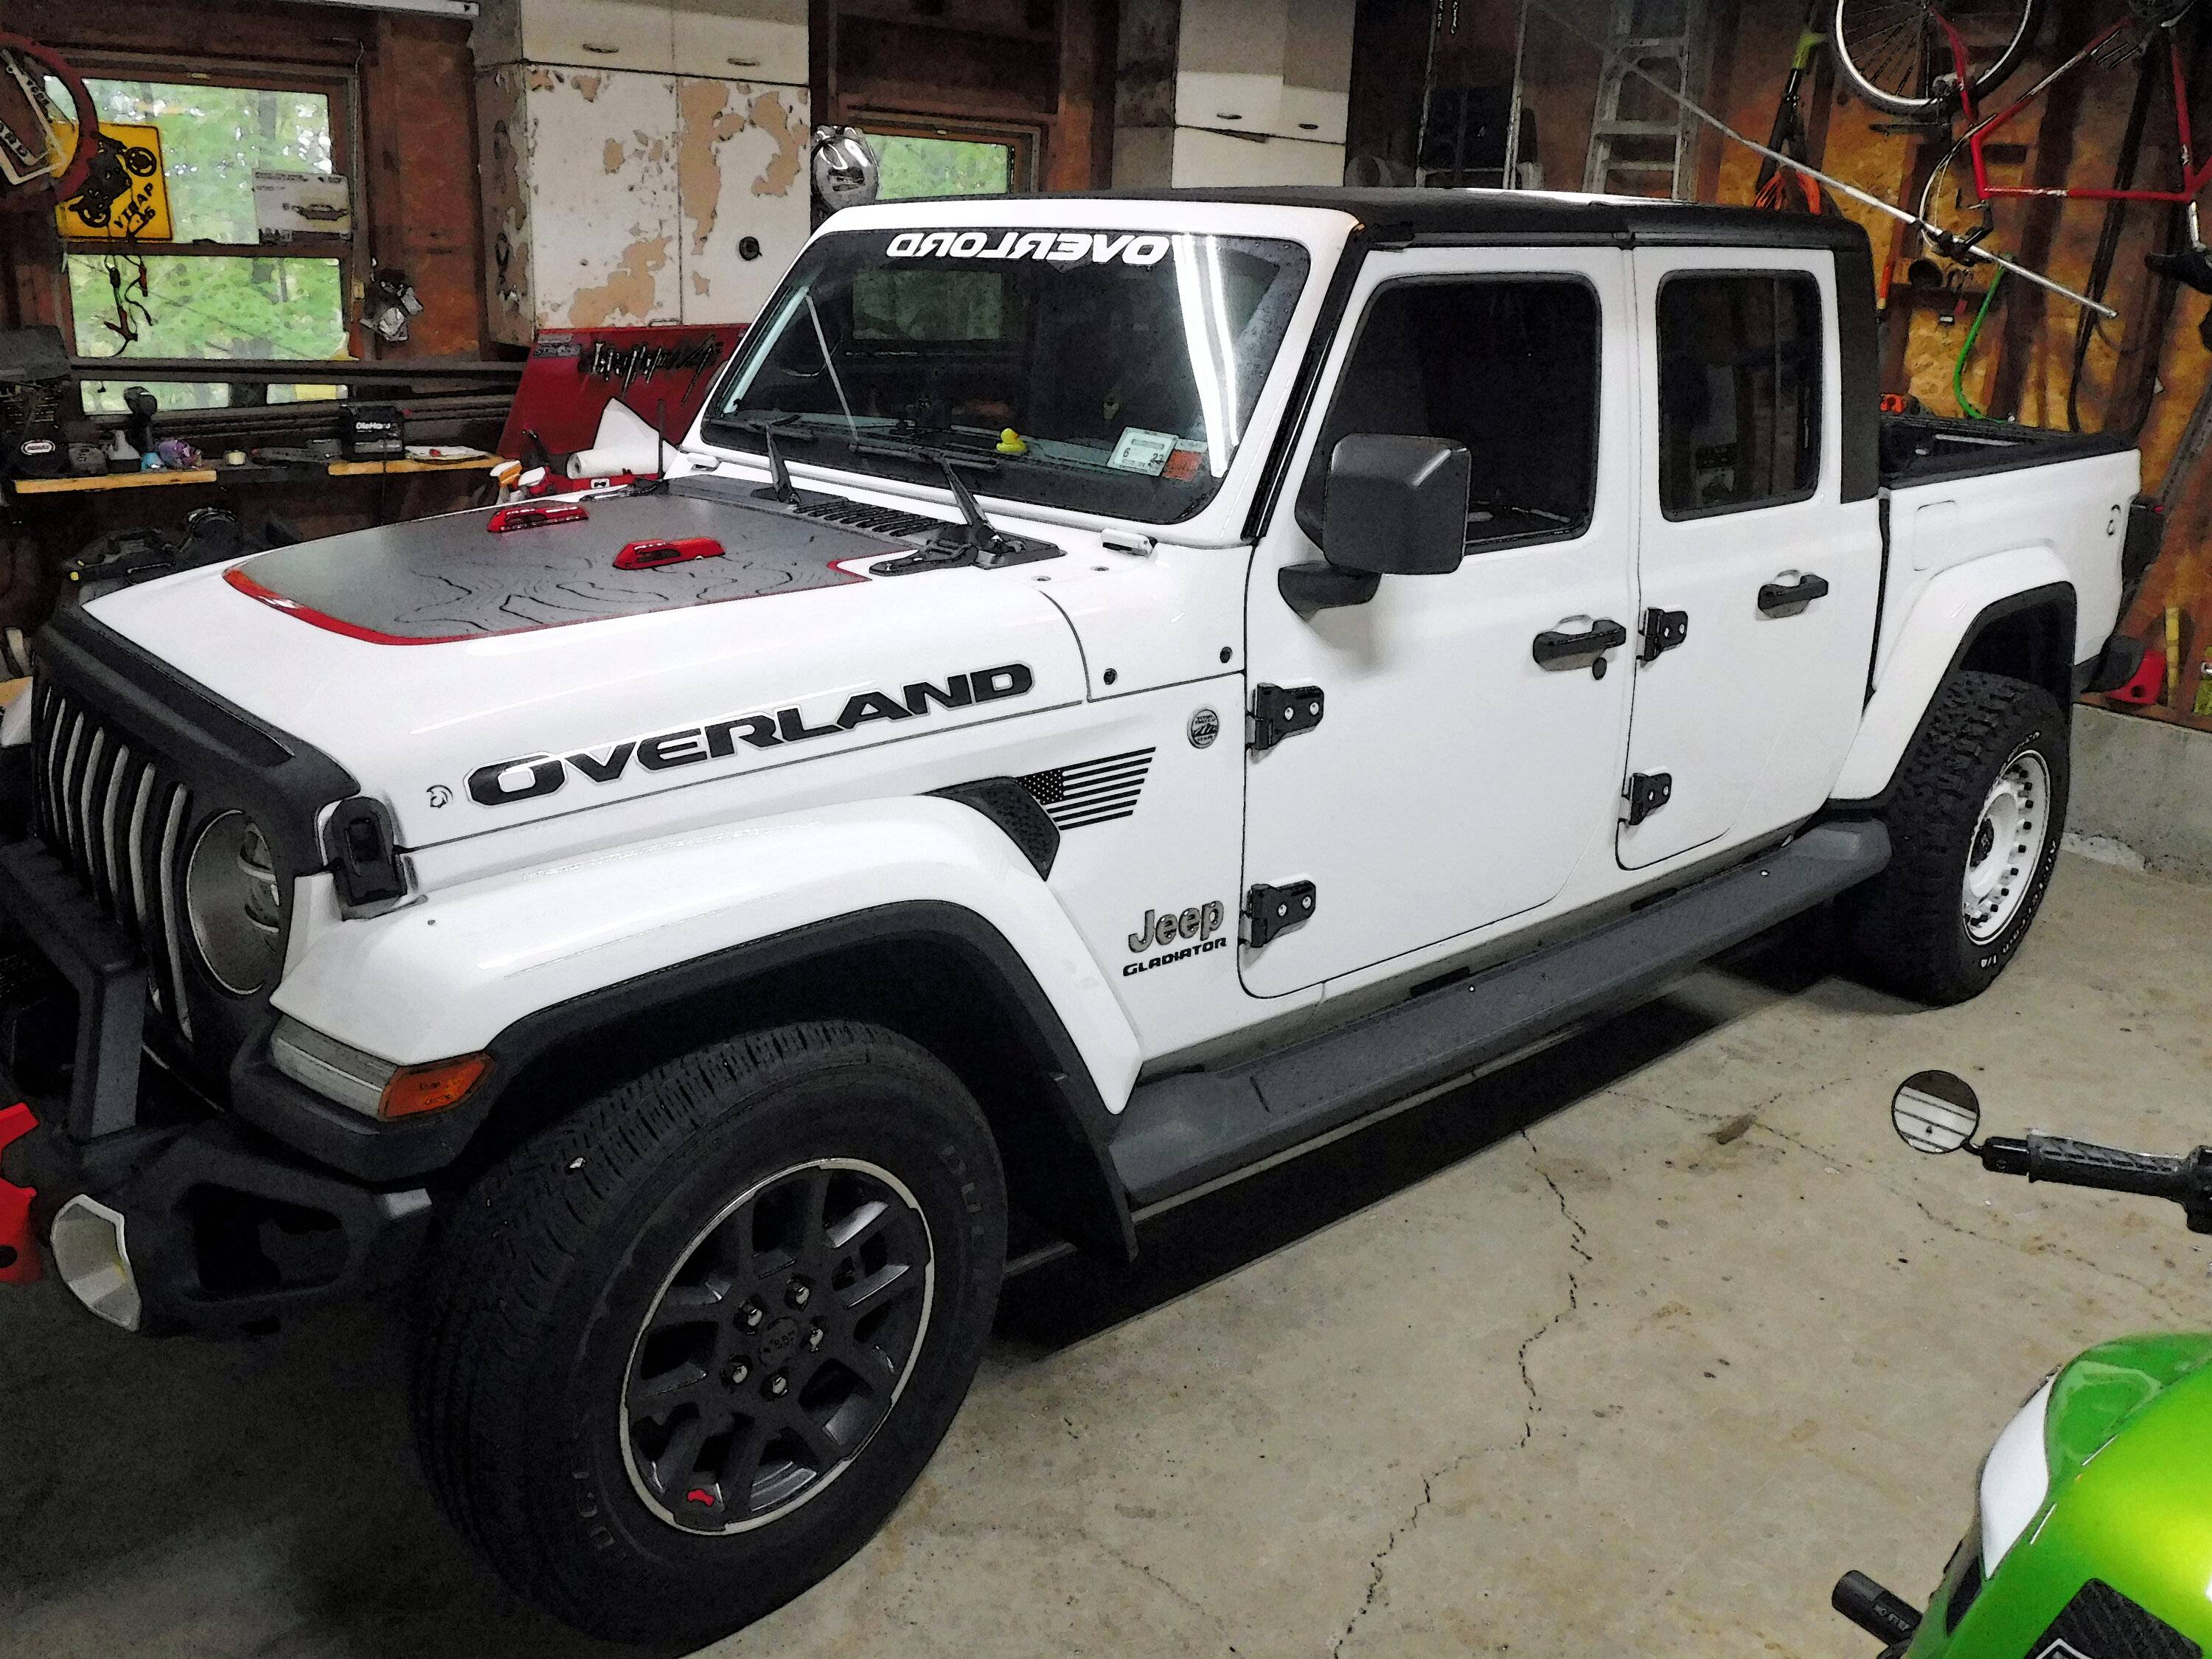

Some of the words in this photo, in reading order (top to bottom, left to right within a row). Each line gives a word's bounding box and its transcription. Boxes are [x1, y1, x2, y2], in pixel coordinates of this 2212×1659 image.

[1123, 448, 1131, 458] 6
[465, 661, 1034, 807] OVERLAND
[1128, 900, 1224, 953] Jeep
[1123, 937, 1227, 977] GLADIATOR
